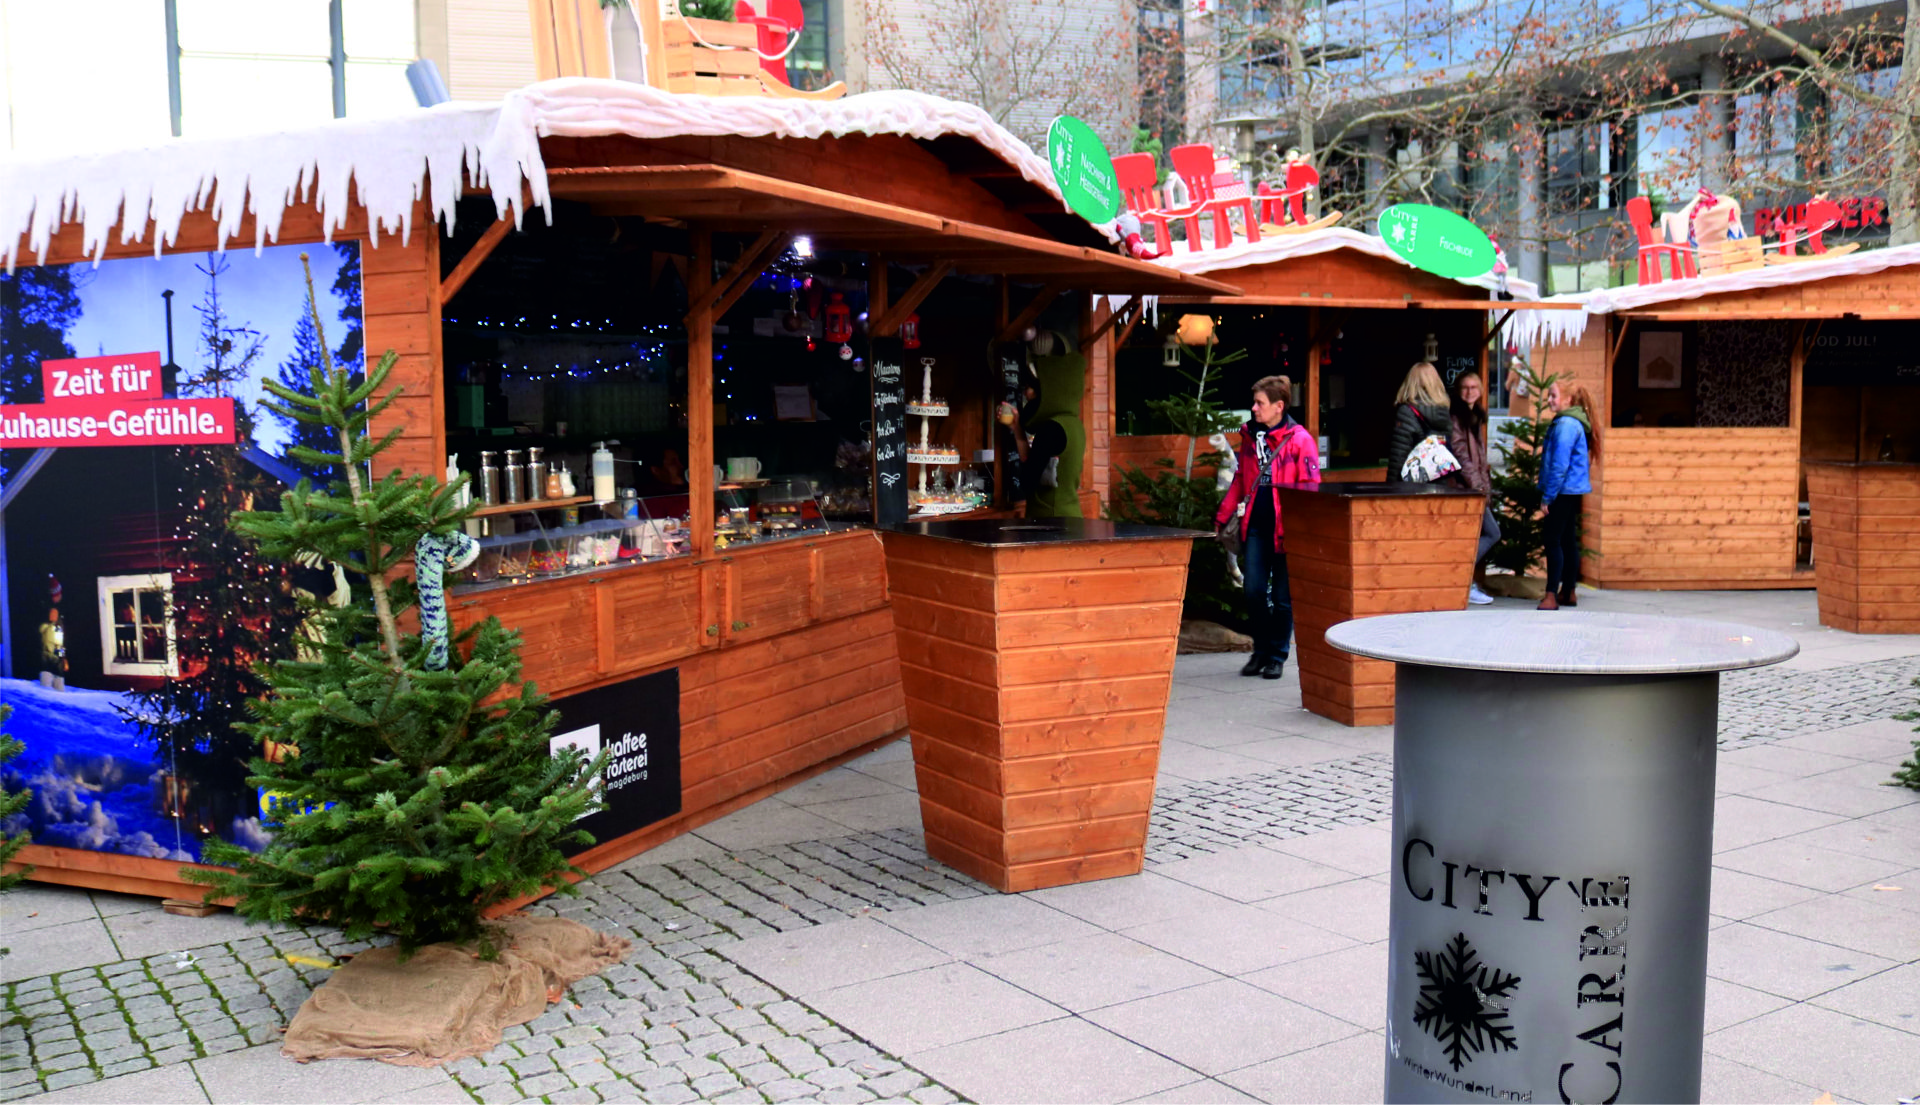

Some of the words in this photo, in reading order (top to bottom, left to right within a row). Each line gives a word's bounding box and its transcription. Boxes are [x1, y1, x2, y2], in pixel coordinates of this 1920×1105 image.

[1845, 335, 1877, 347] JUL!
[52, 370, 105, 397] Zeit
[110, 365, 152, 390] für
[0, 406, 223, 437] uhause-Gefühle.
[608, 748, 647, 779] rösterei
[608, 770, 647, 791] magdeburg
[1402, 838, 1560, 921] CITY
